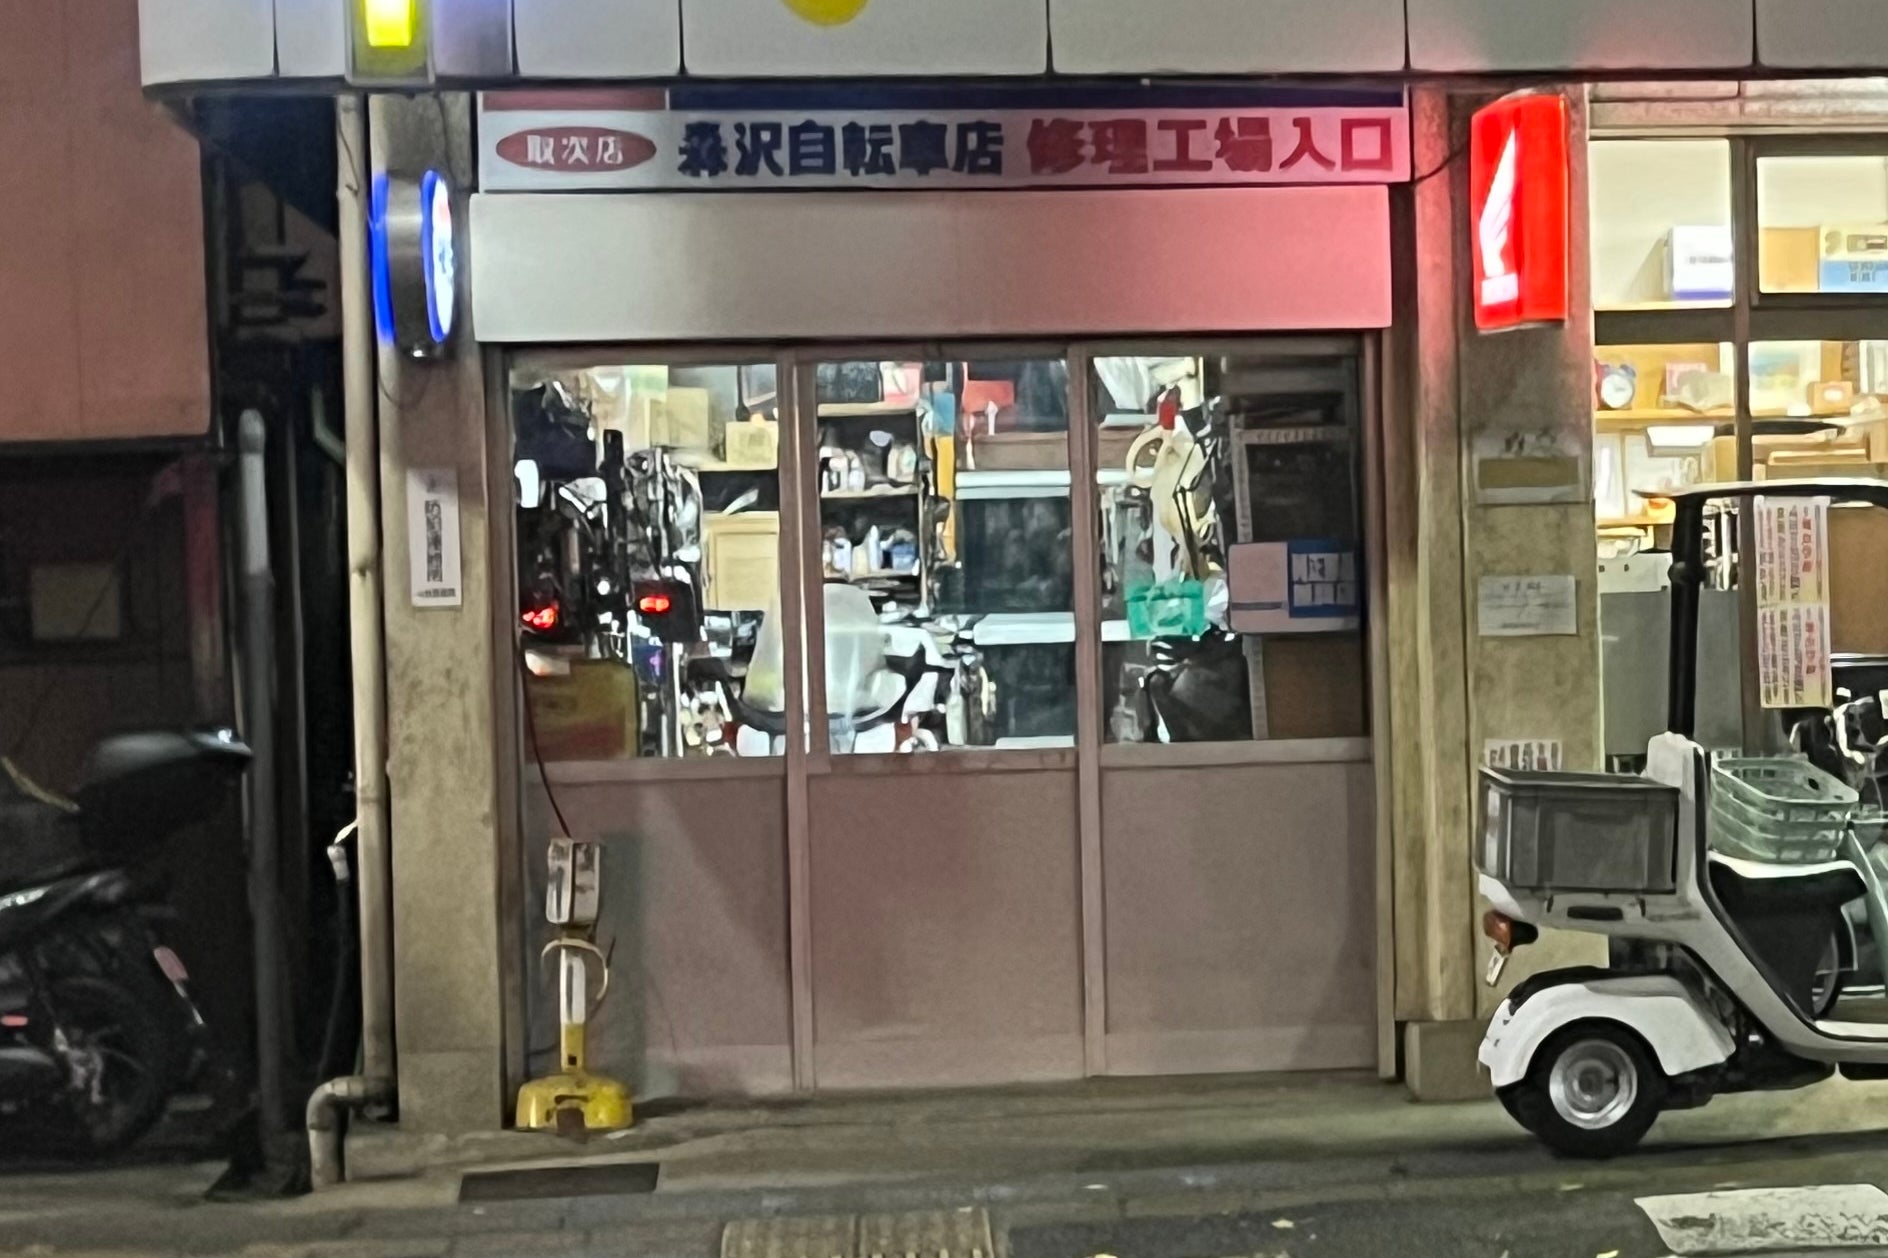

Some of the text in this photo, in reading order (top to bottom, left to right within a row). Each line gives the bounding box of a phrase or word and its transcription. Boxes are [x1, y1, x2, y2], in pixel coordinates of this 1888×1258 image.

[526, 134, 623, 166] 取次店
[677, 116, 1393, 178] 森沢自転車店 修理工場入口
